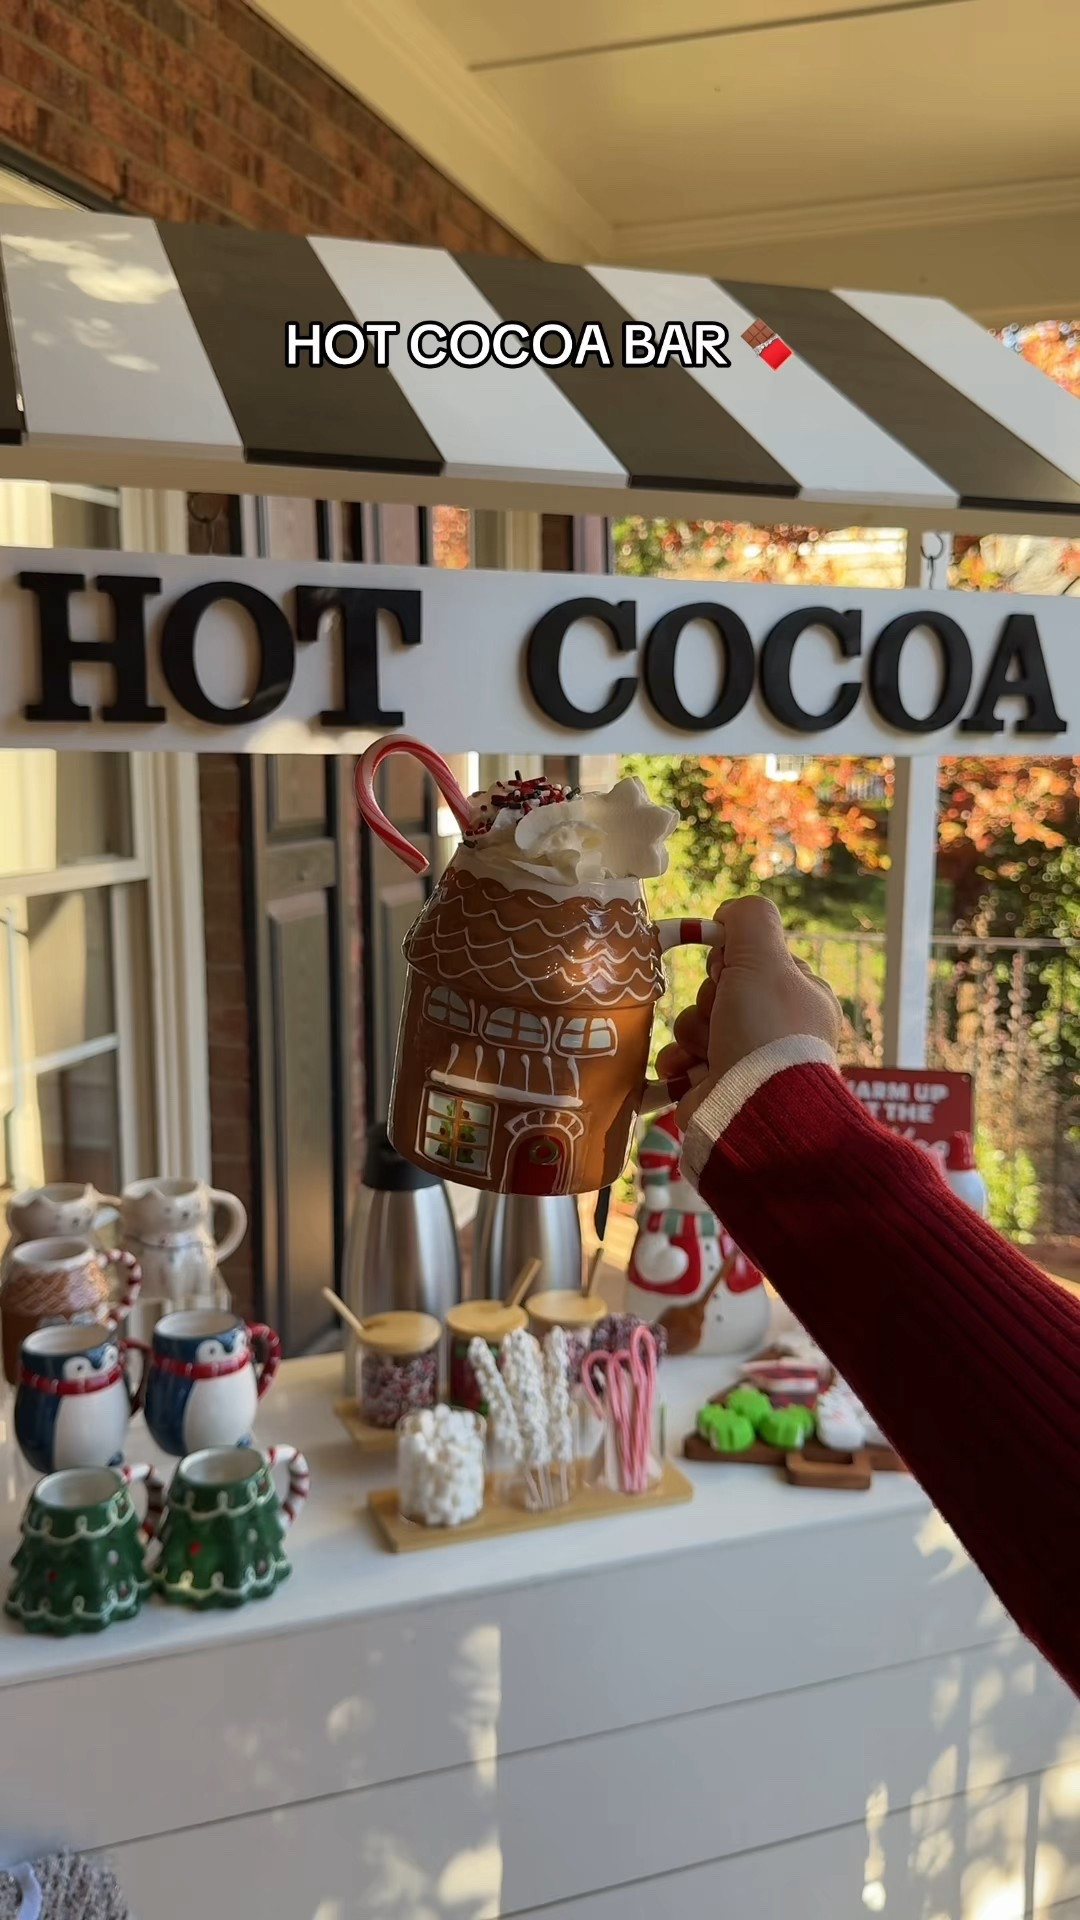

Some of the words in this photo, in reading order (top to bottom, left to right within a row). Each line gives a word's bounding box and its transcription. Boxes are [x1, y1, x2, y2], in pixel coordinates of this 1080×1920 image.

[17, 571, 422, 727] HOT
[525, 597, 1068, 735] COCOA
[913, 1082, 949, 1104] UP
[883, 1102, 934, 1124] THE
